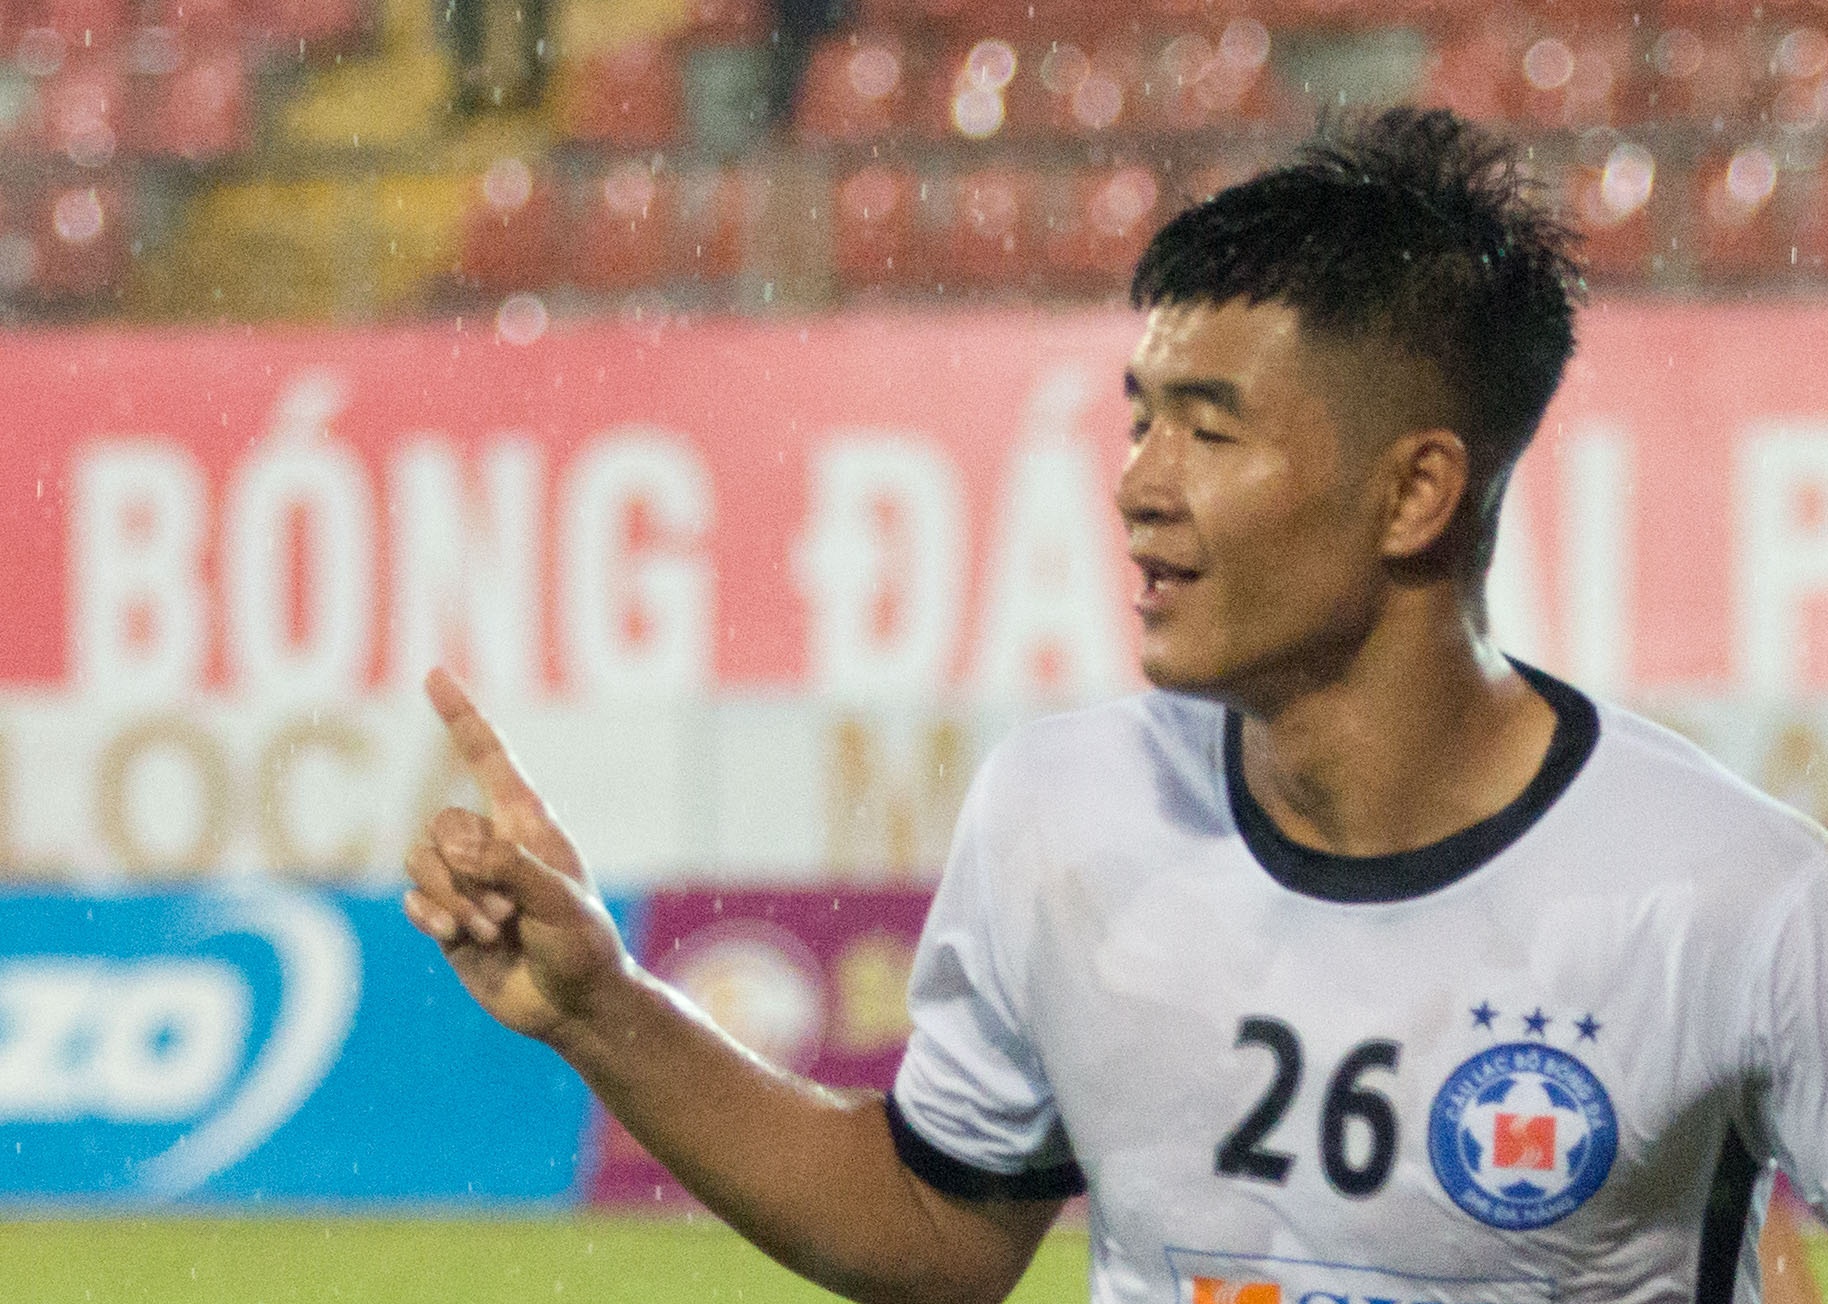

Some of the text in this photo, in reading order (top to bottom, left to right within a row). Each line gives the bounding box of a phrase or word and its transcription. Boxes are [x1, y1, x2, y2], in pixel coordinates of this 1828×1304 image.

[68, 365, 712, 698] BÓNG
[790, 365, 1140, 704] ĐÁ
[1214, 1014, 1402, 1197] 26
